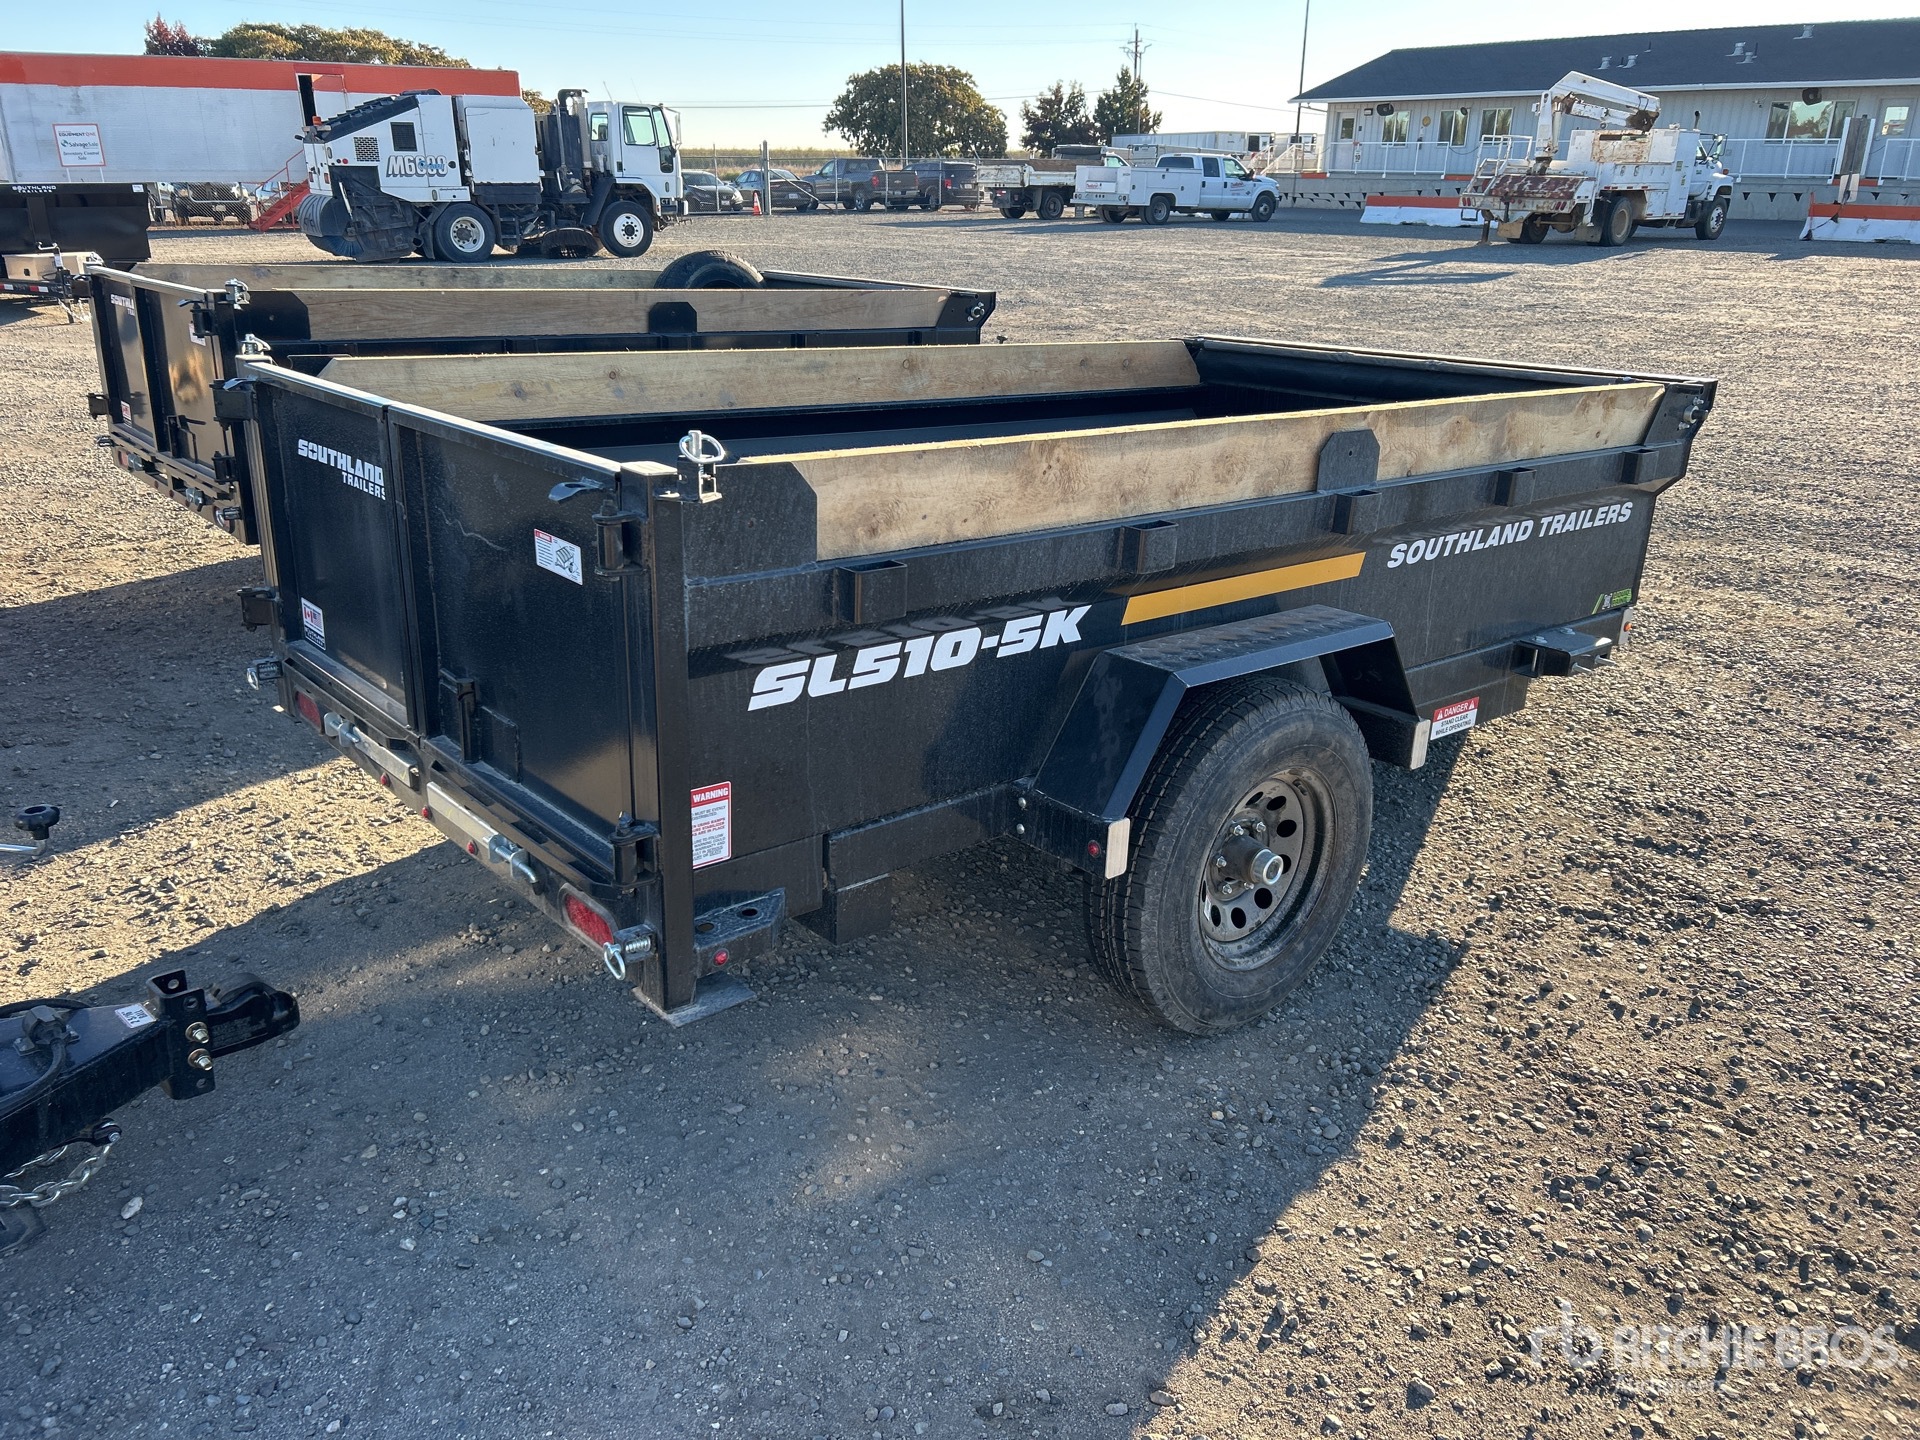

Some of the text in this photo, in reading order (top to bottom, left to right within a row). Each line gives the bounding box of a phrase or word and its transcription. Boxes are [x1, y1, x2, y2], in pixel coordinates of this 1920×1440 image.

[298, 438, 384, 486] SOUTHLAND
[342, 471, 386, 500] TRAILERS
[1386, 502, 1634, 568] SOUTHLAND TRAILERS
[1444, 702, 1469, 717] DANGER
[1436, 719, 1472, 736] WHILE OPERATING
[1440, 714, 1468, 727] STAND CLEAR
[693, 788, 728, 803] WARNING
